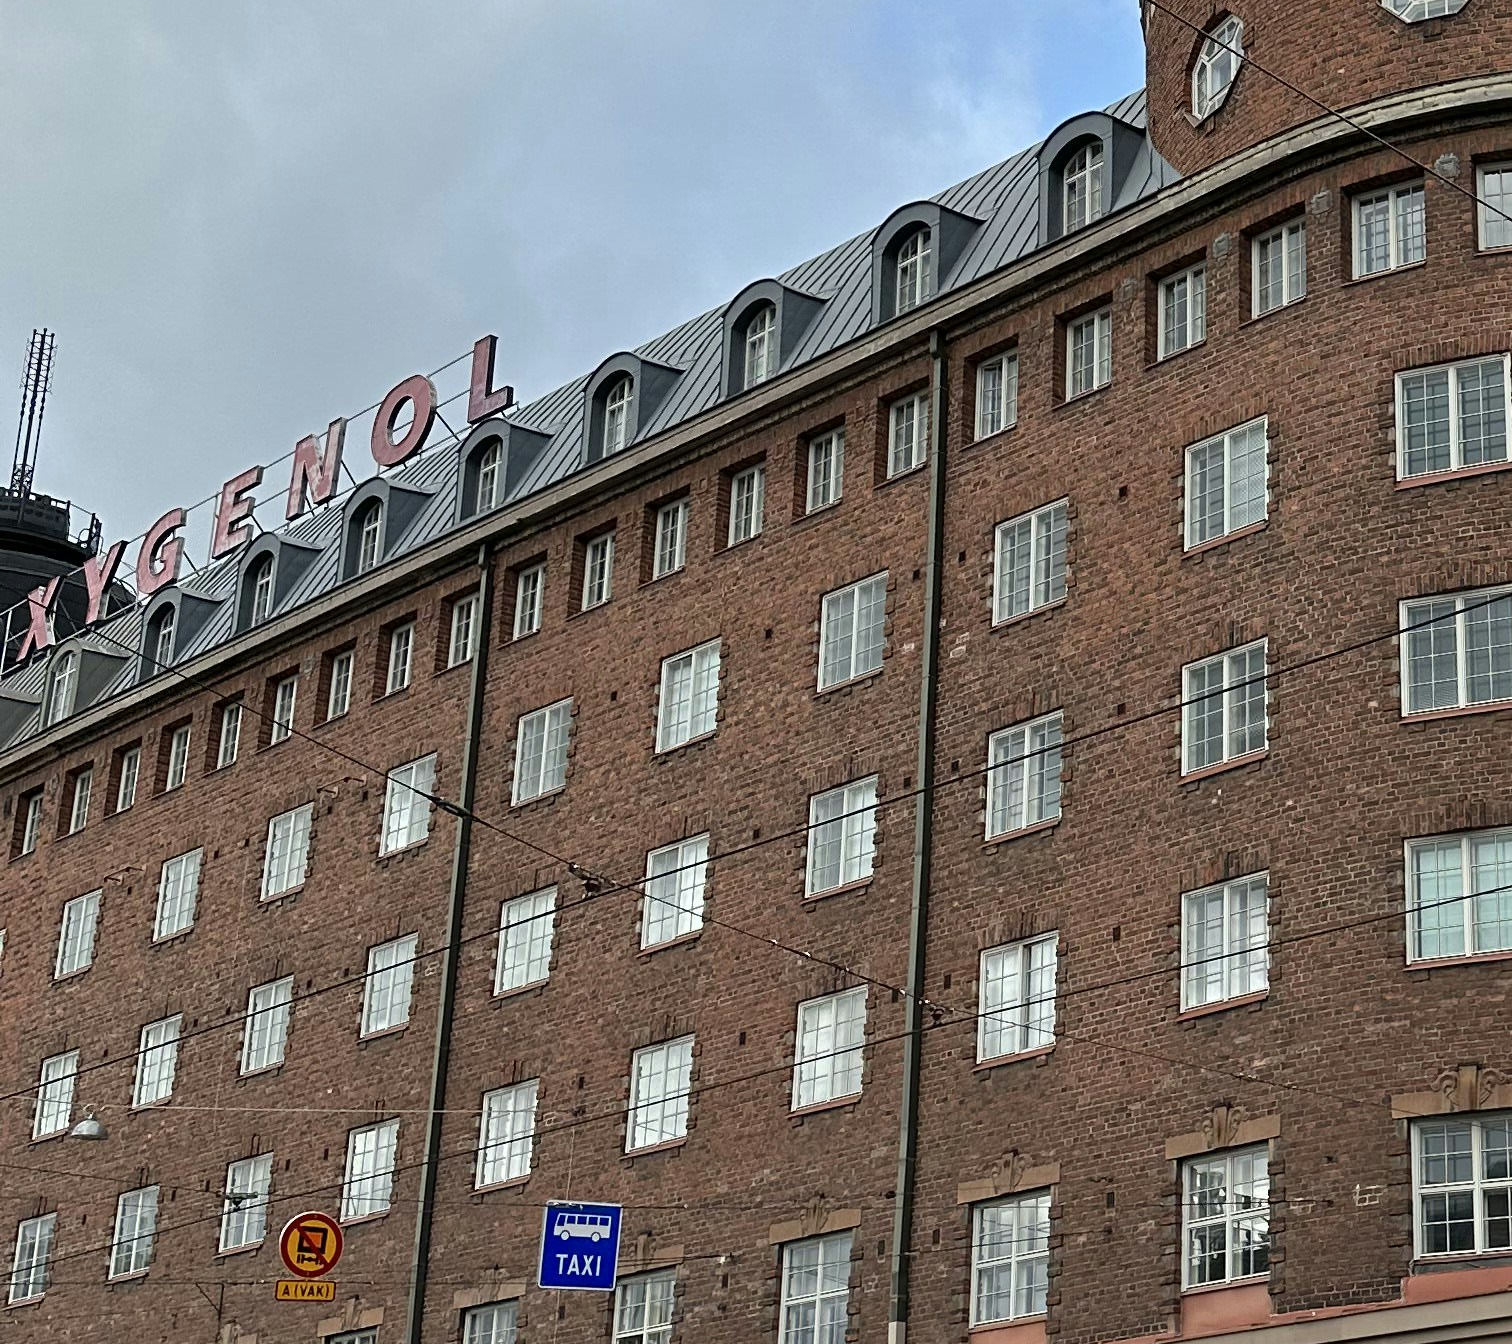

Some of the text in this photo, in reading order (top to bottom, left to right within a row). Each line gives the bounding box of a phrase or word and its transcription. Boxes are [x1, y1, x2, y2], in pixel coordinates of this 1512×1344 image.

[556, 1253, 602, 1277] TAXI
[281, 1283, 330, 1299] A (VAK)
